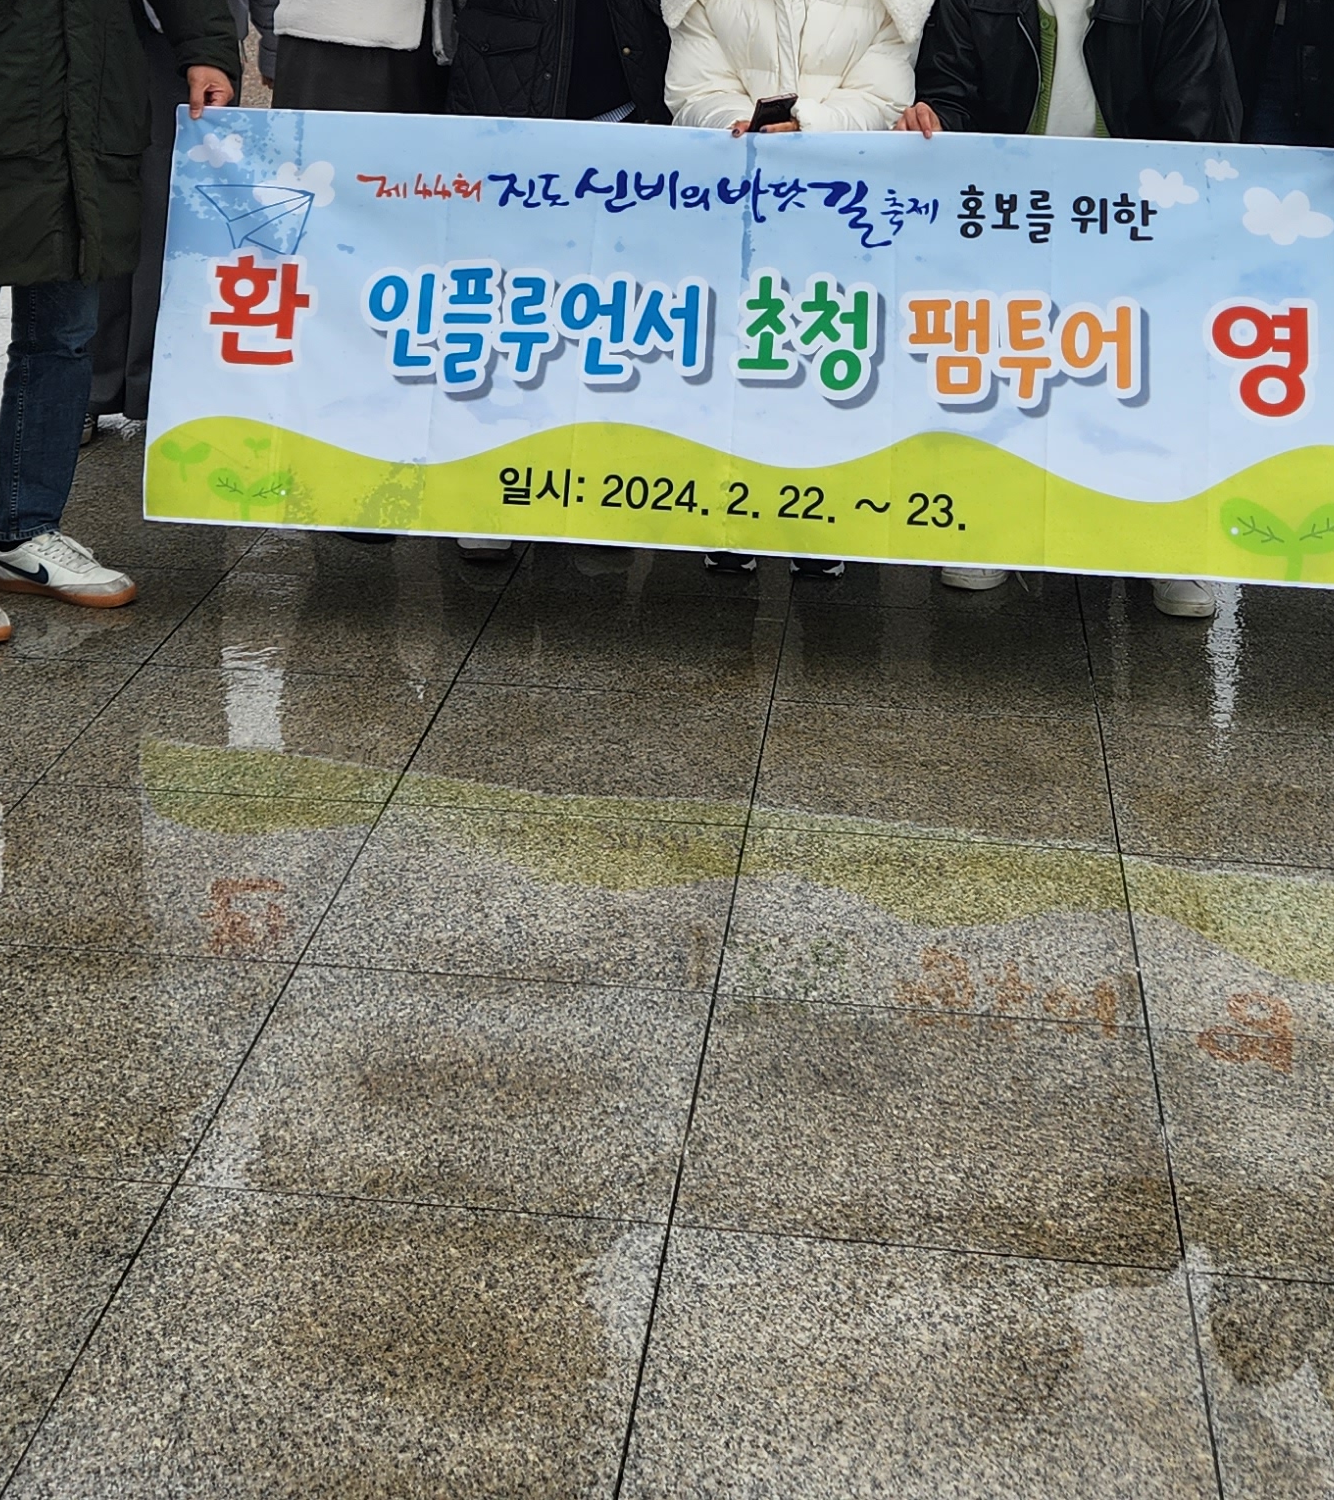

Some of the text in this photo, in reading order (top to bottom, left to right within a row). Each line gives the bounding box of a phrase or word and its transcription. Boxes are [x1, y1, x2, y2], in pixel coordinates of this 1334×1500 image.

[356, 167, 1158, 249] 제44회 진도 신비의 바닷길 축제 홍보를 위한
[209, 255, 1310, 418] 환 인플루언서 초청 팸투어 영
[498, 466, 585, 508] 일시:
[600, 473, 710, 516] 2024.
[725, 481, 760, 519] 2.
[776, 484, 836, 524] 22.
[905, 491, 967, 531] 23.
